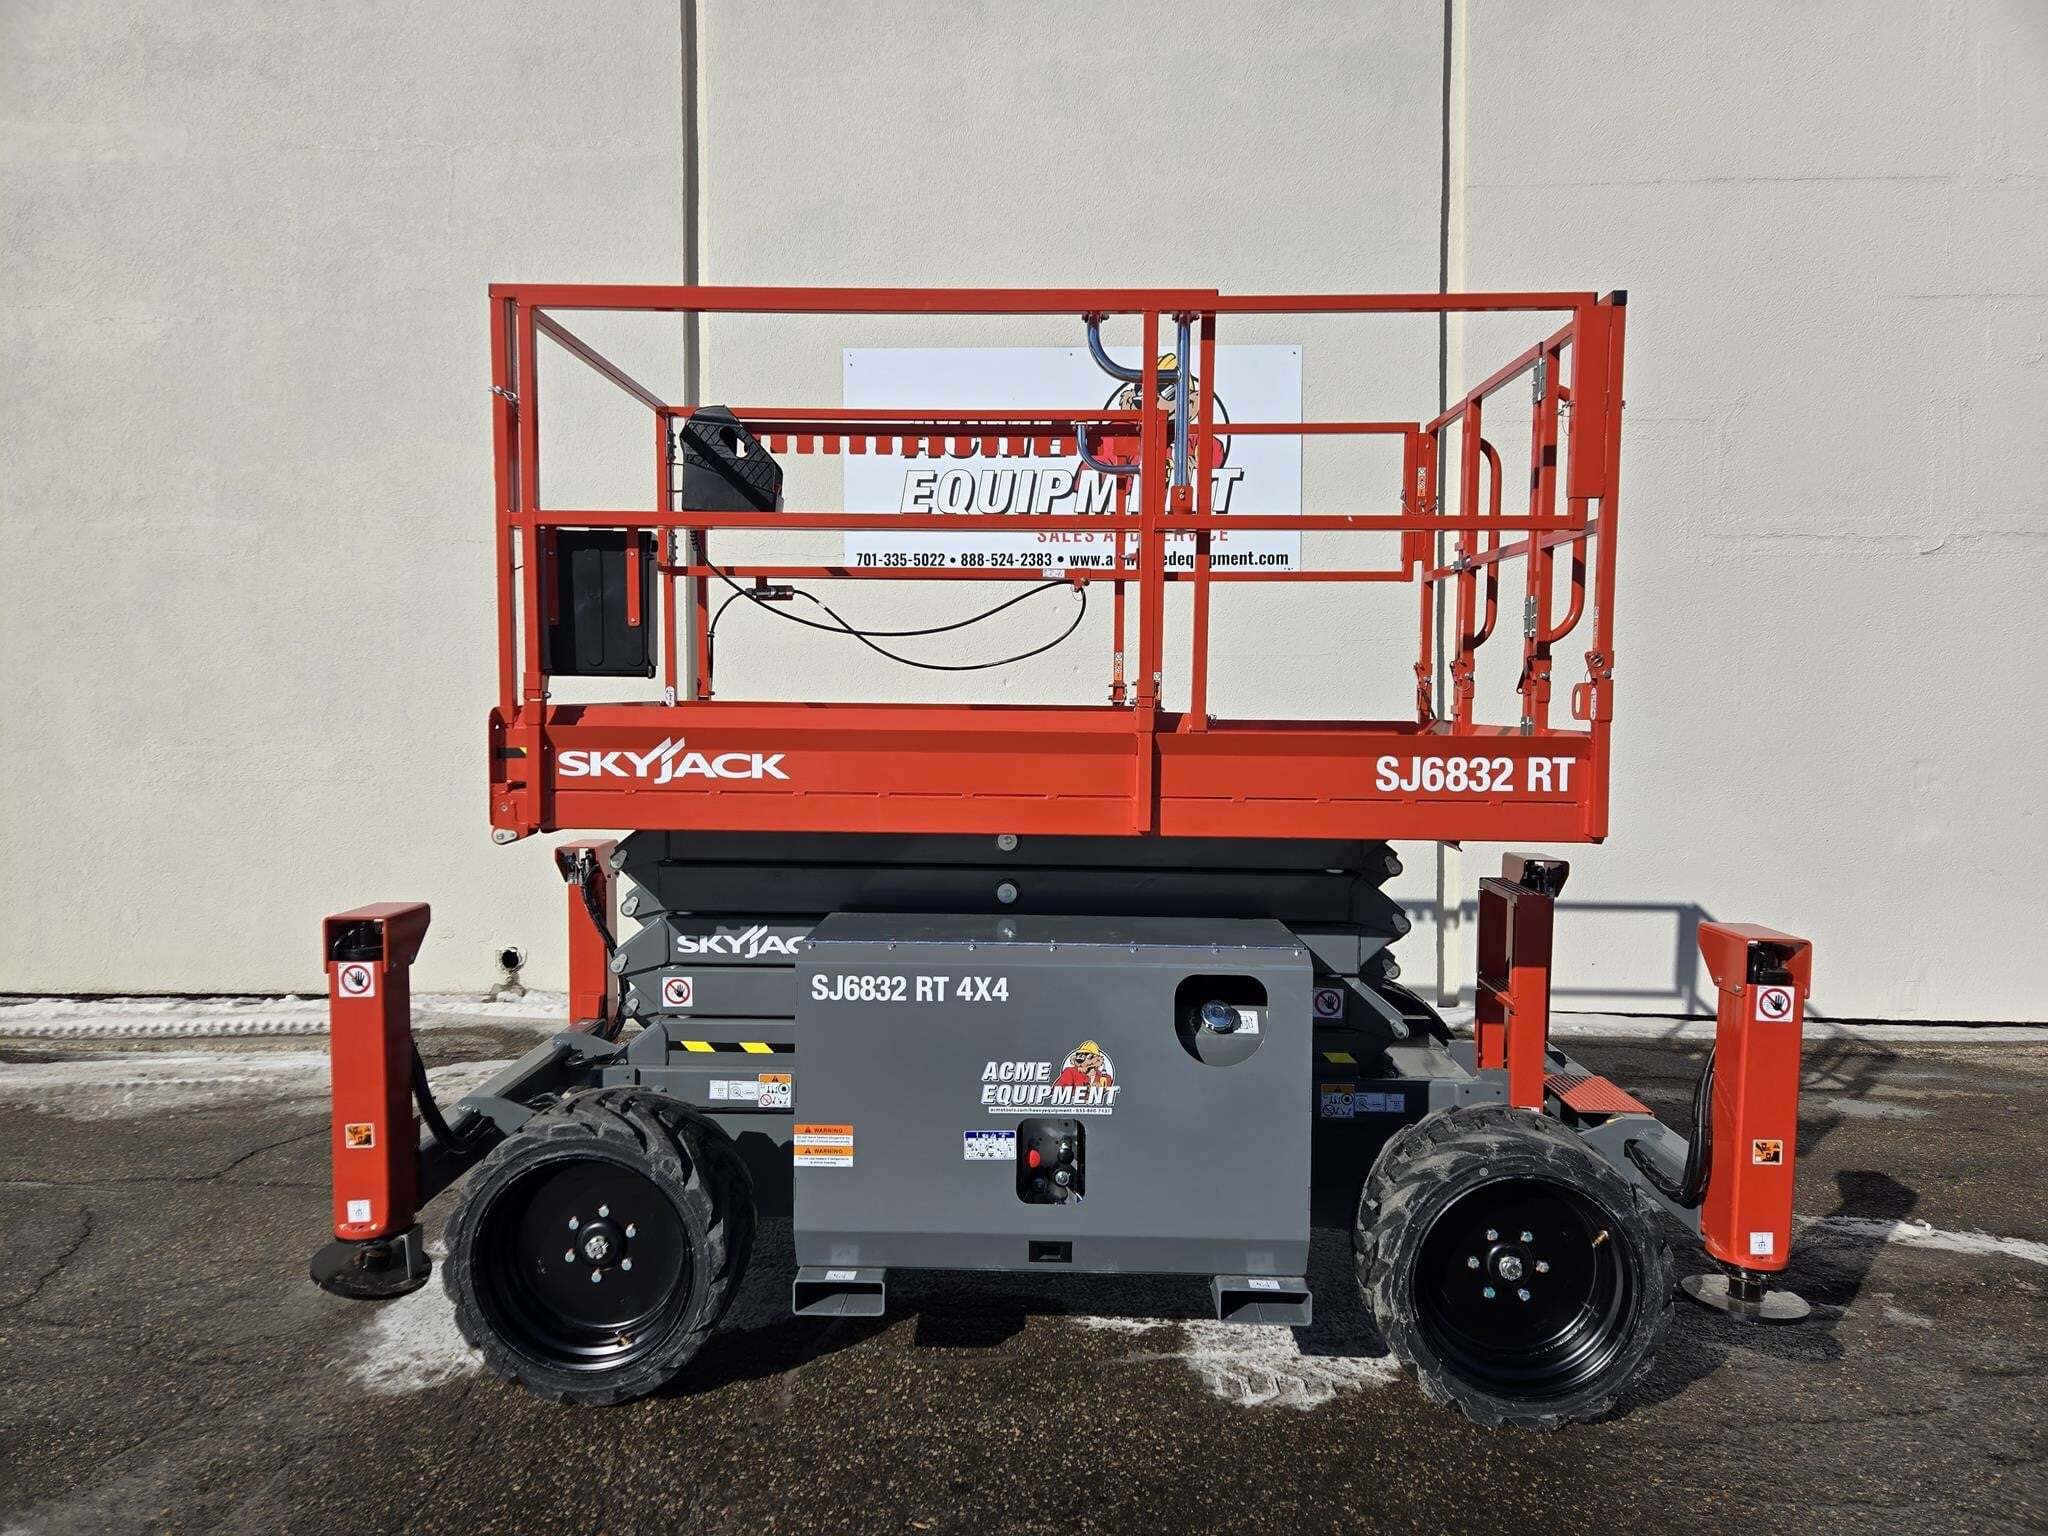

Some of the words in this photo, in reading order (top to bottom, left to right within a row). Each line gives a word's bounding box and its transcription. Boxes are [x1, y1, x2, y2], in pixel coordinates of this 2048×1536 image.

[856, 552, 945, 567] 701-335-5022
[960, 552, 1051, 567] 888-524-2383
[558, 737, 791, 784] SKYJACK
[1375, 755, 1514, 792] SJ6832
[1527, 756, 1577, 792] RT
[677, 925, 806, 959] SKYJAC
[811, 974, 907, 1001] SJ6832
[916, 976, 950, 1002] RT
[956, 976, 1010, 1002] 4X4
[981, 1061, 1053, 1082] ACME
[981, 1084, 1121, 1106] EQUIPMENT
